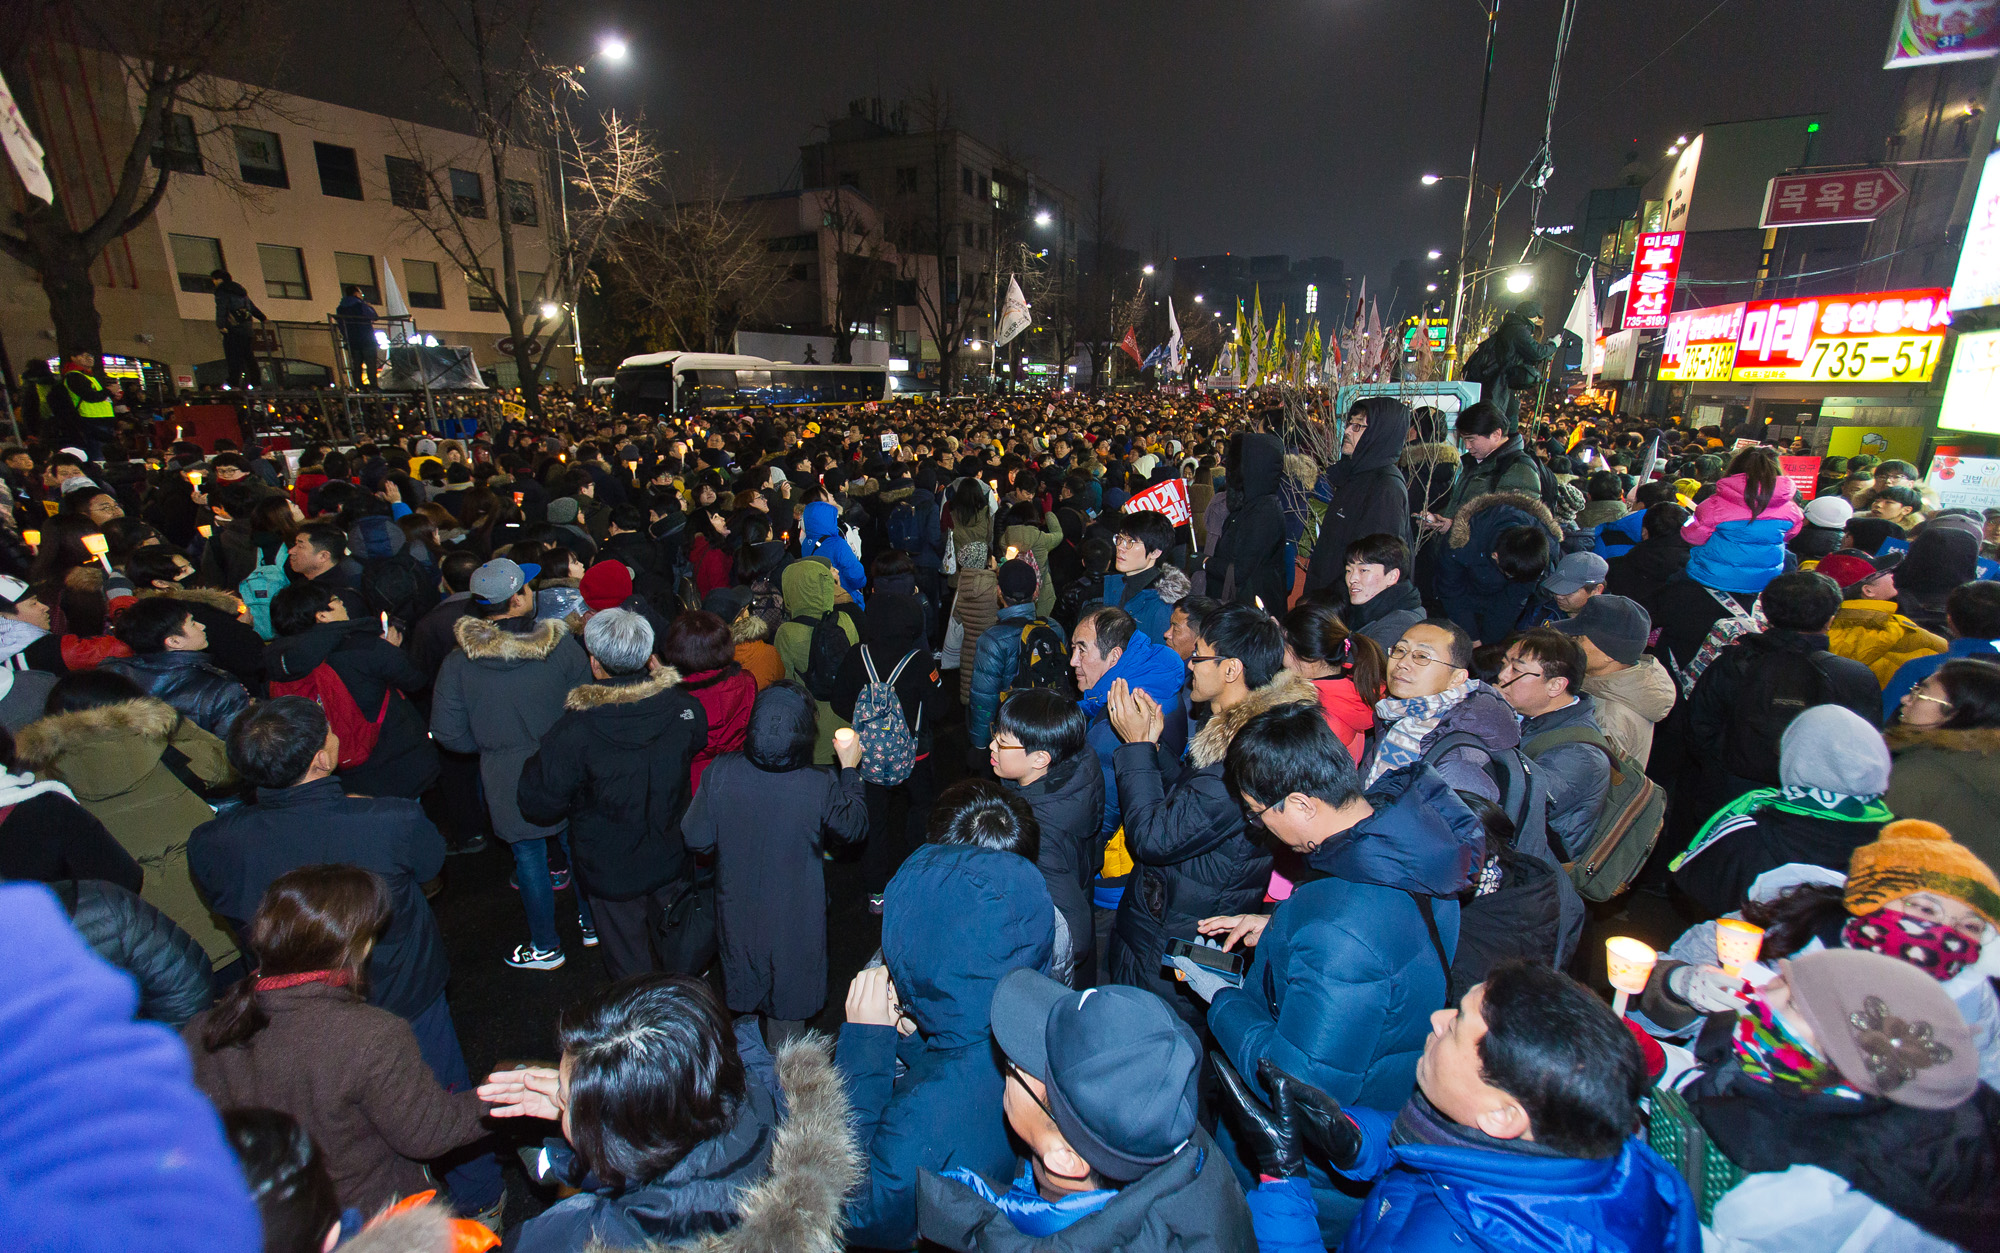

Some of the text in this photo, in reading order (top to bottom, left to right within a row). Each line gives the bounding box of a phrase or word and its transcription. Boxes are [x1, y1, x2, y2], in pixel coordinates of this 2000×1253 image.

[1937, 34, 1961, 48] 3F
[1778, 178, 1886, 215] 목욕탕
[1643, 234, 1681, 248] 미래
[1632, 248, 1674, 317] 부동산
[1626, 316, 1668, 329] 735-5199
[1739, 301, 1818, 361] 미래
[1682, 344, 1734, 378] 735-5199
[1798, 463, 1816, 473] 요구
